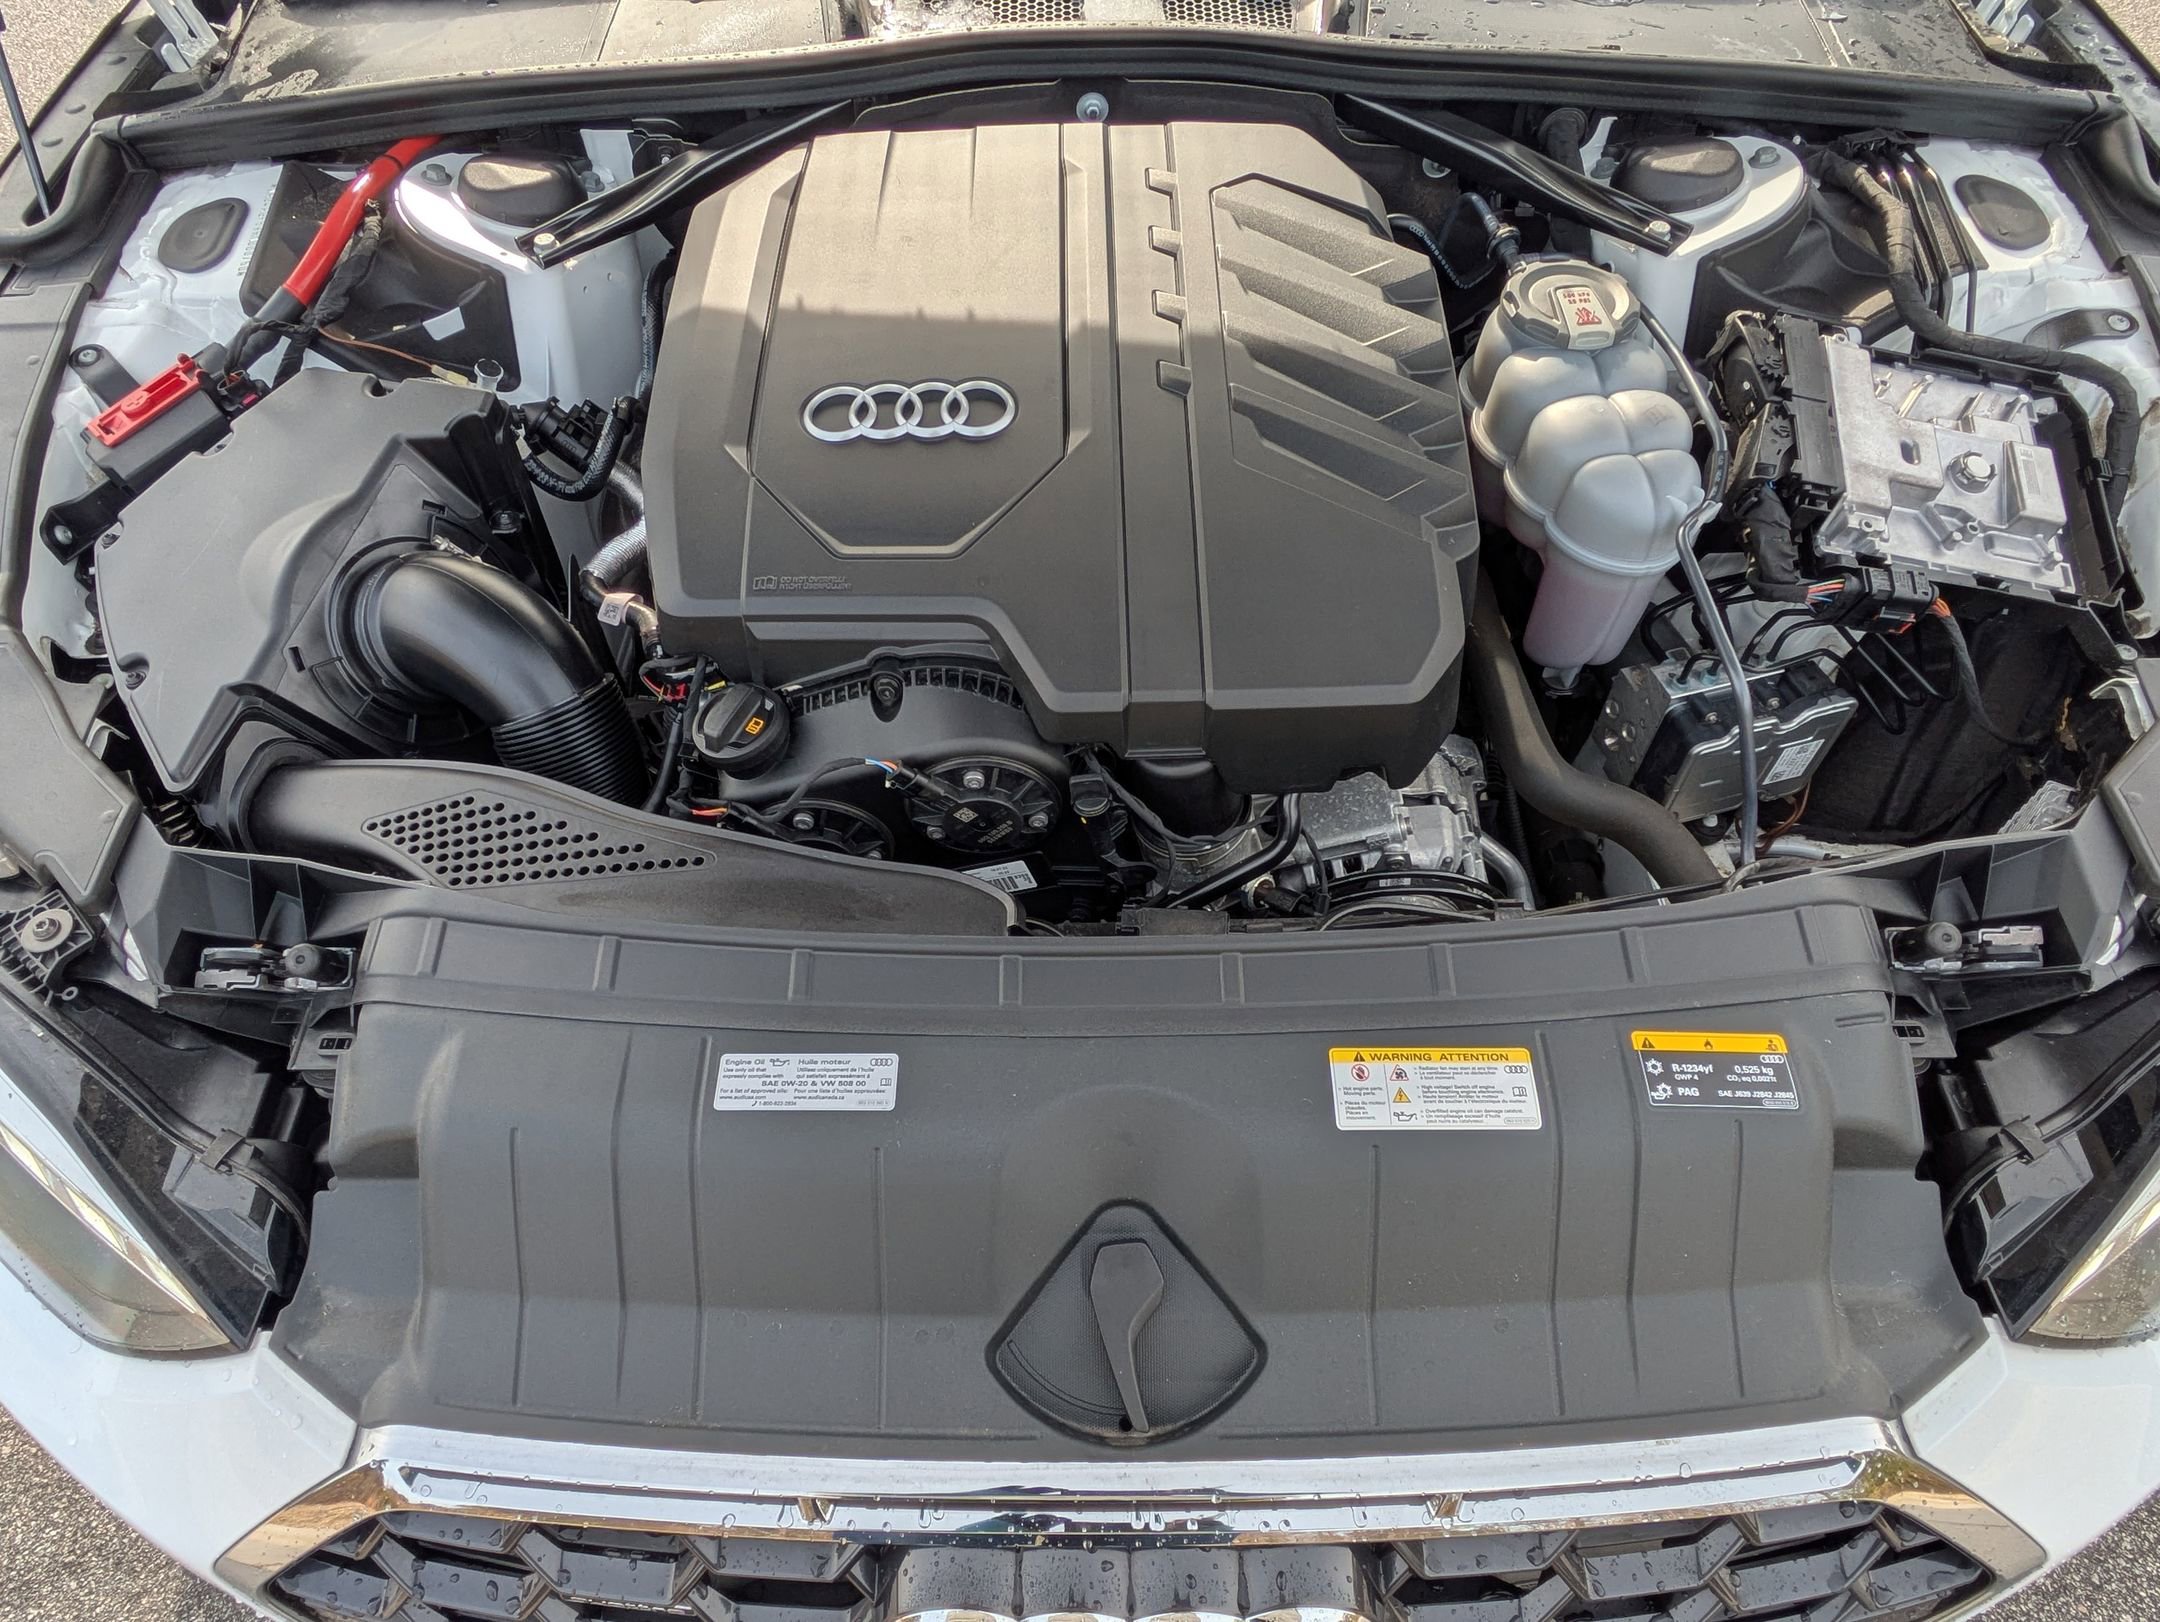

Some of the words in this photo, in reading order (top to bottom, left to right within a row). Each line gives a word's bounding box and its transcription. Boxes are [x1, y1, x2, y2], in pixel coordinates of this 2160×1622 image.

[1672, 1064, 1714, 1074] R-1234yf
[1761, 1066, 1774, 1076] kg
[1678, 1088, 1700, 1096] PAG
